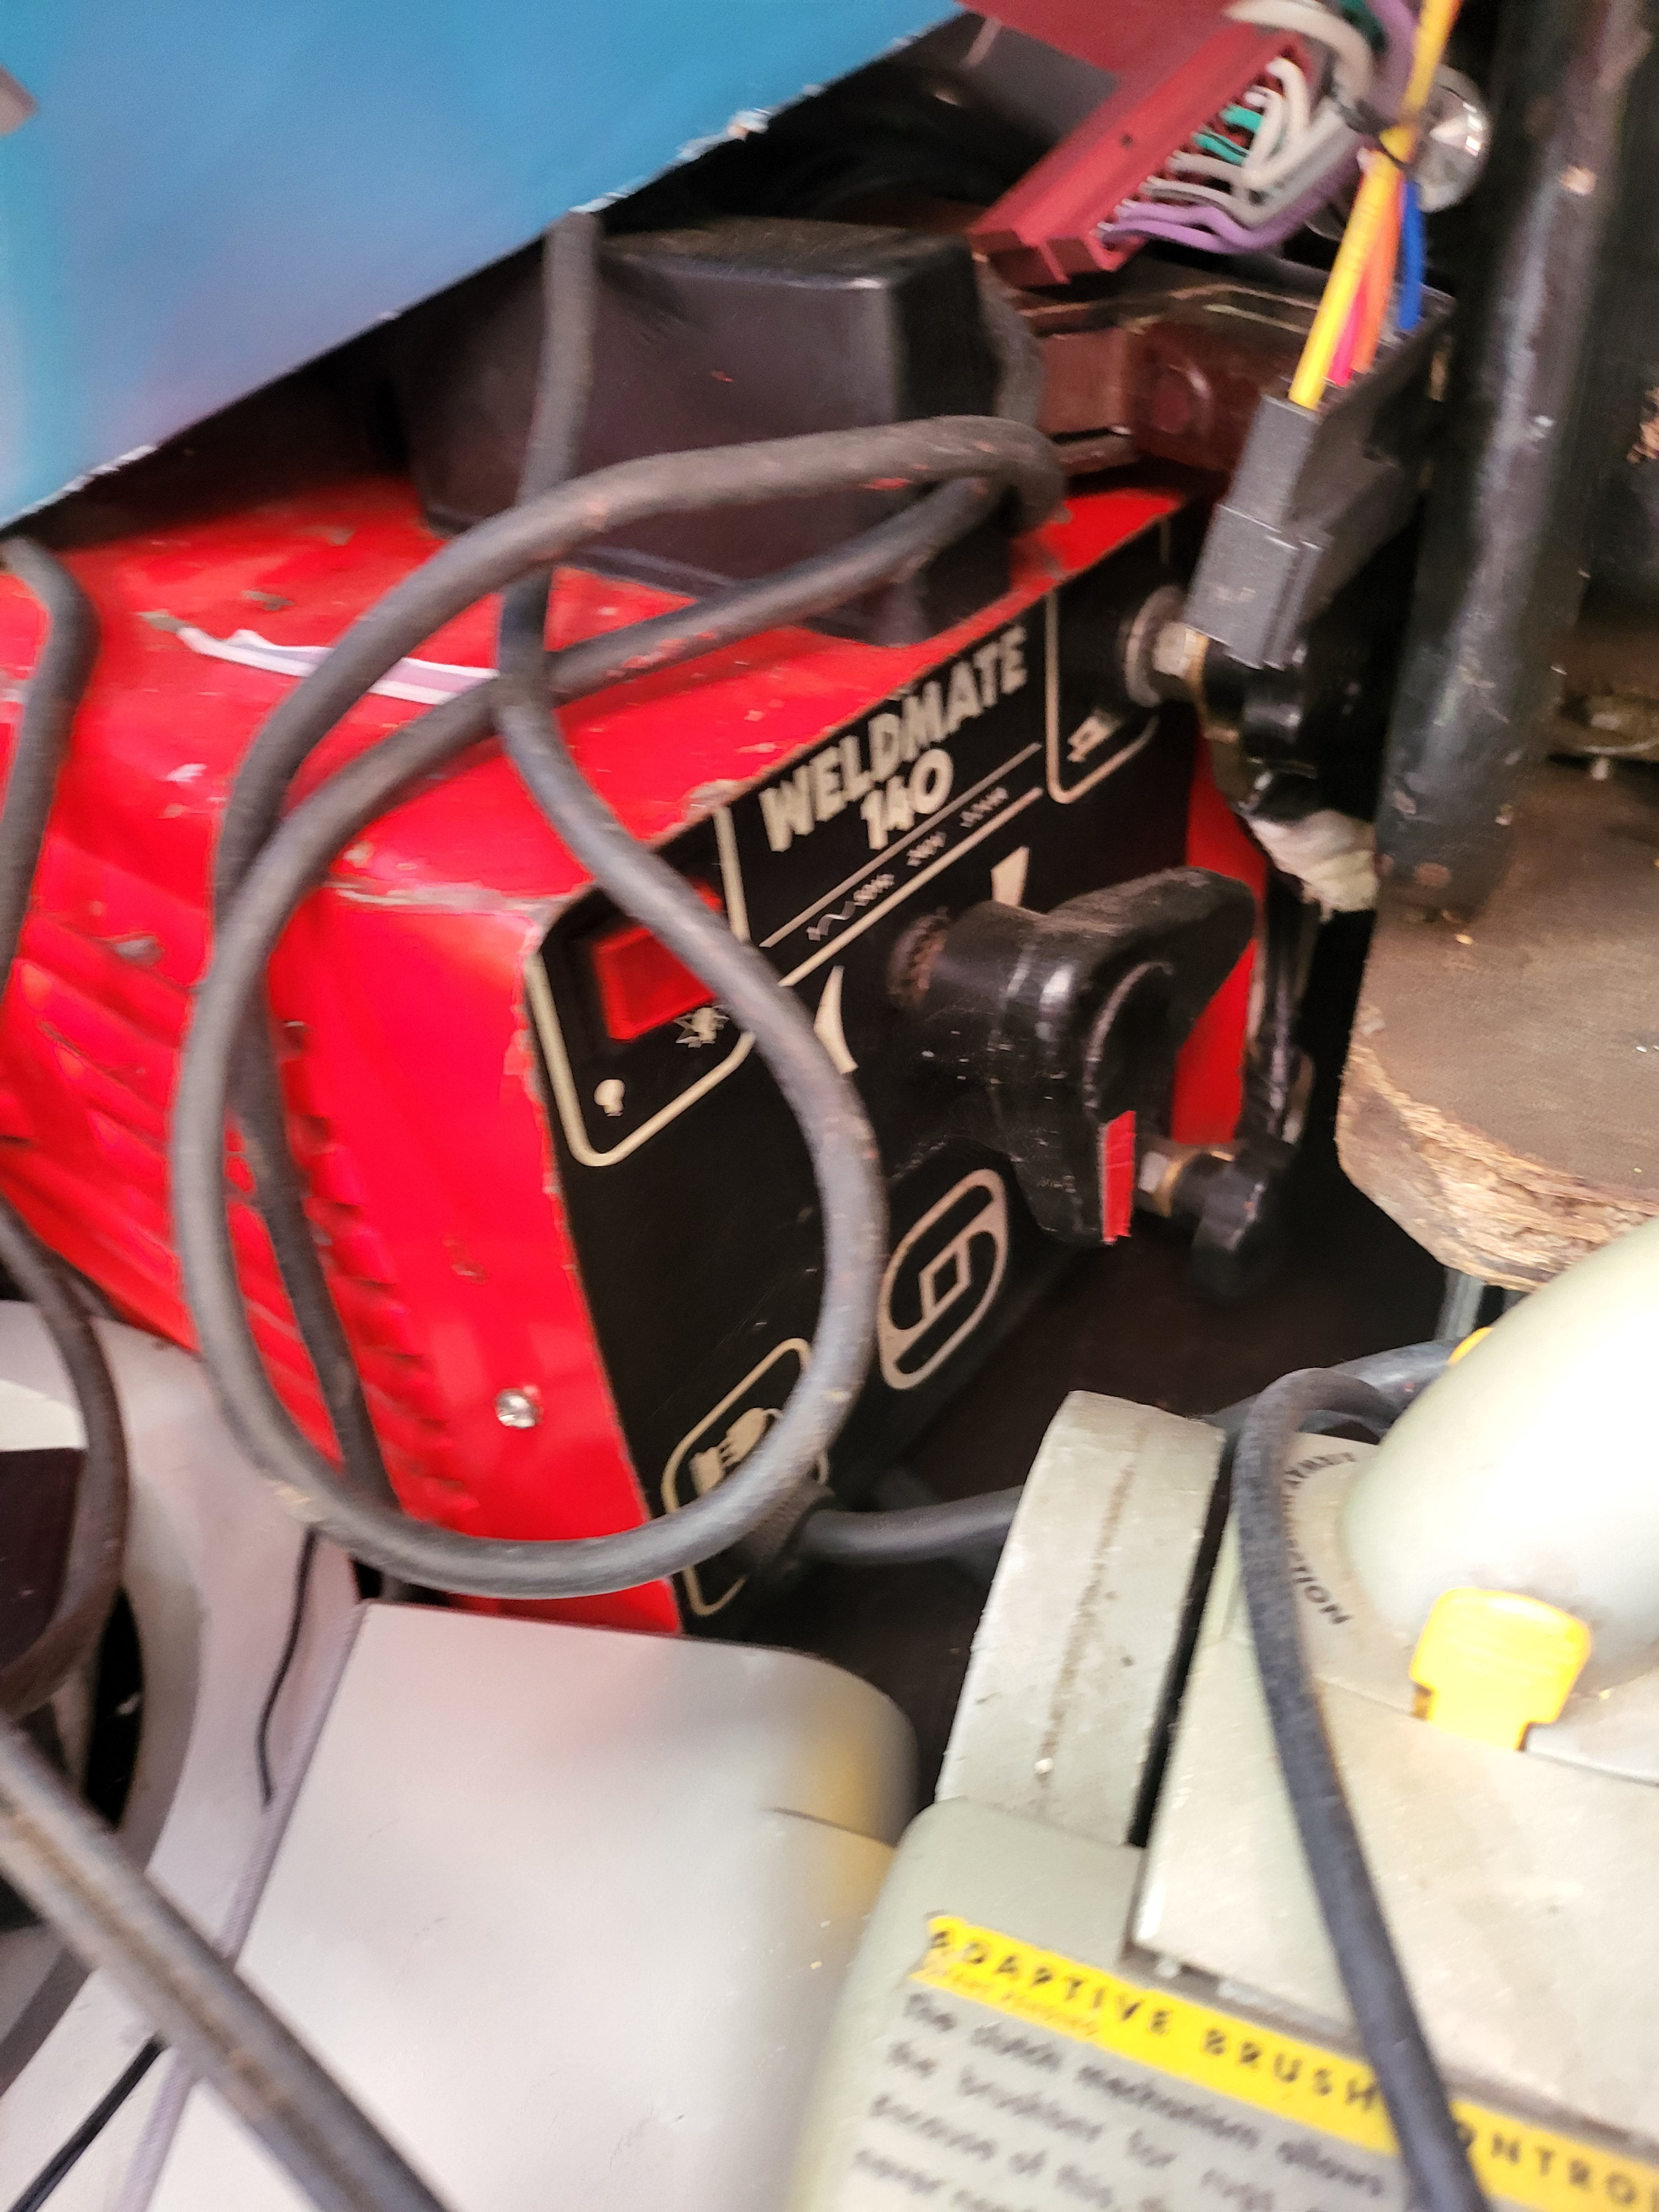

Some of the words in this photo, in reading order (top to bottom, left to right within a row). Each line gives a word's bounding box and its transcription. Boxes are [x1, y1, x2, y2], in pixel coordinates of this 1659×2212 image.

[759, 625, 1029, 852] WELDMATE
[860, 748, 954, 851] 140
[1202, 2026, 1379, 2109] BRUSH
